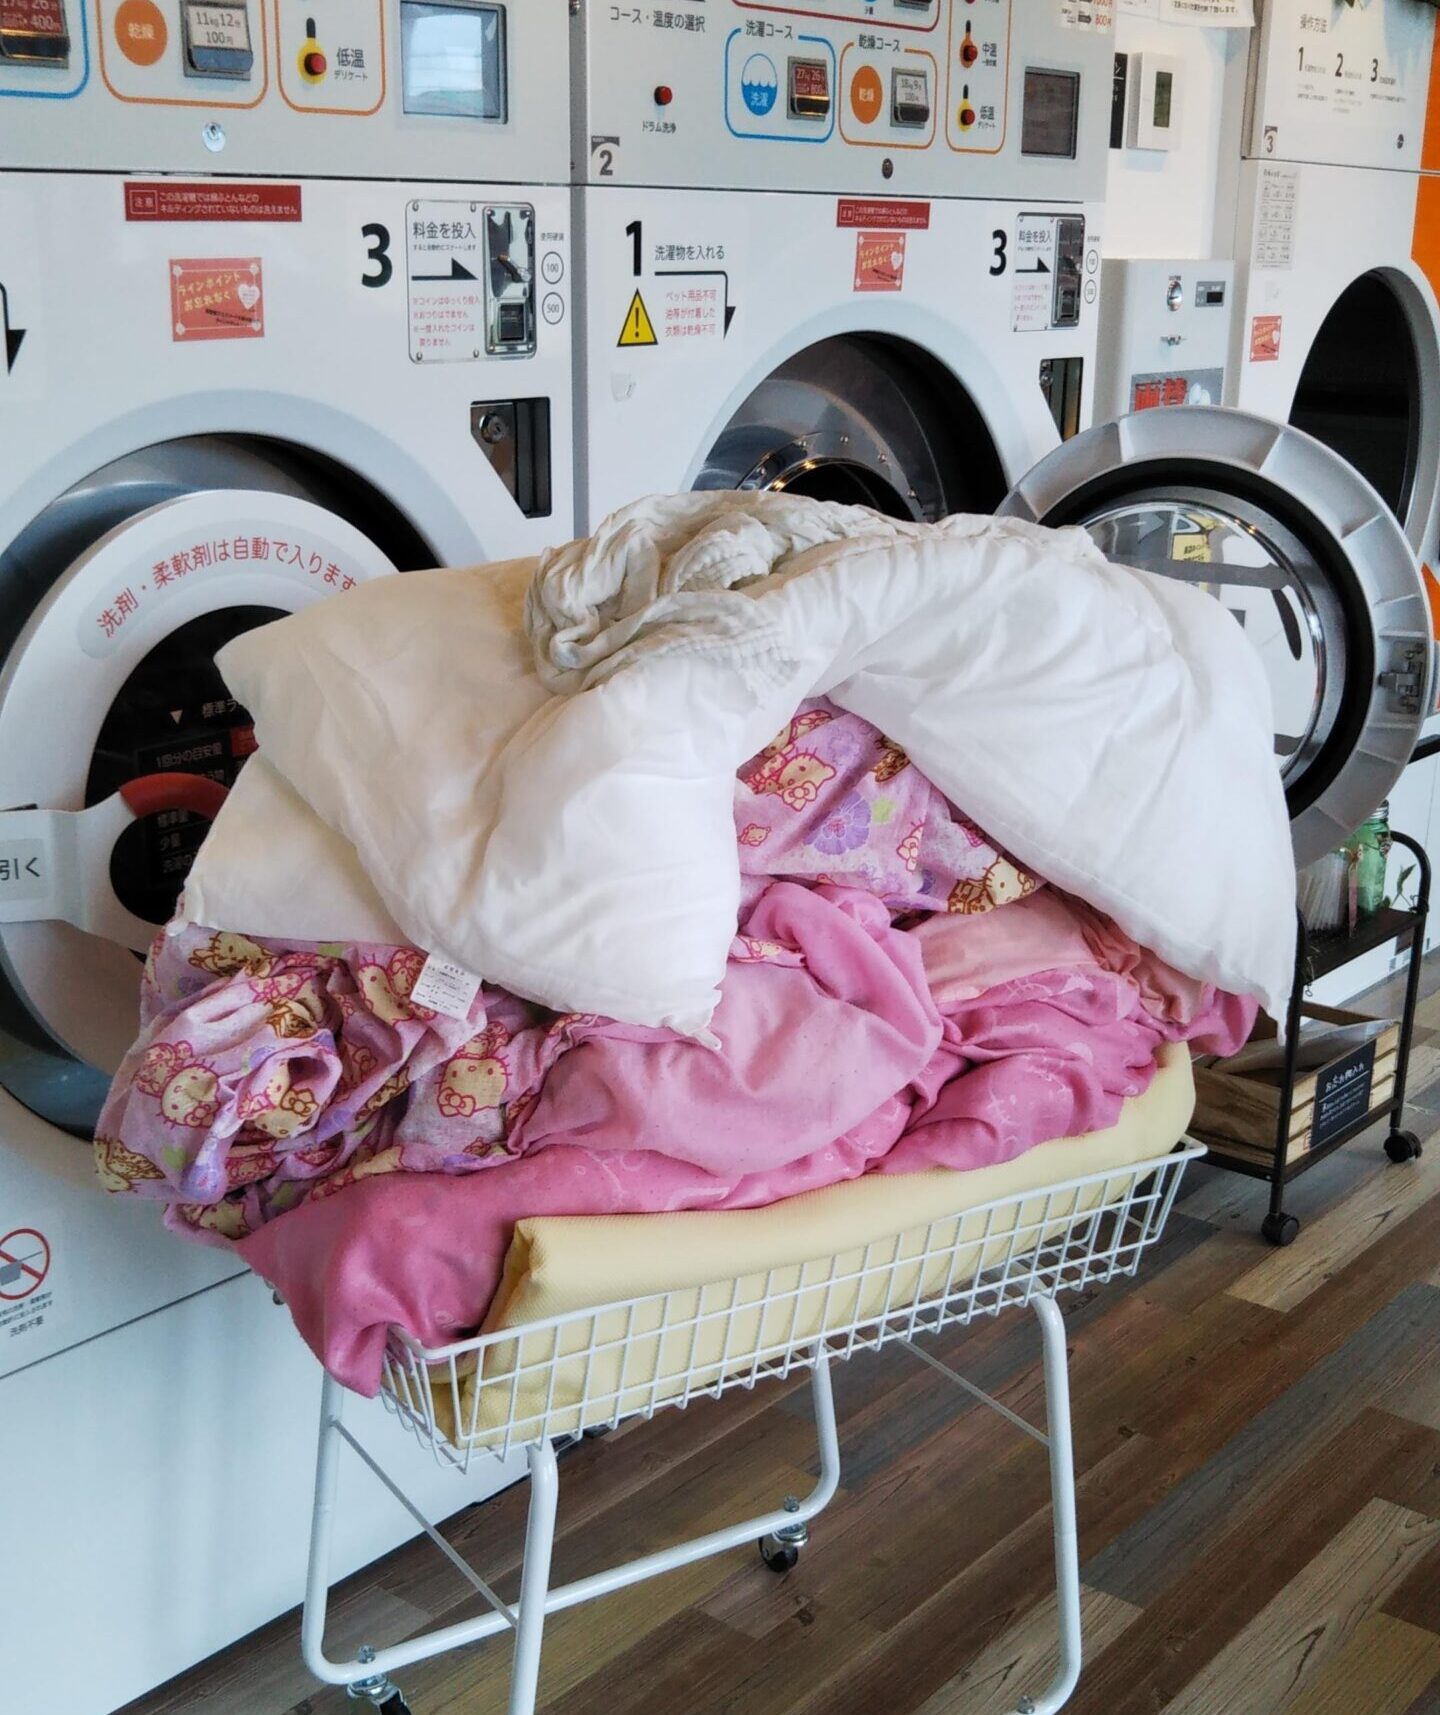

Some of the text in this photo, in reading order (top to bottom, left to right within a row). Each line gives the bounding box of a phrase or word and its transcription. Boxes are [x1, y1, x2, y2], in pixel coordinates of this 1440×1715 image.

[609, 6, 706, 33] コース・温度の選択
[745, 19, 794, 40] 洗濯コース
[858, 33, 901, 53] 乾燥コース
[336, 47, 366, 69] 低温
[1298, 46, 1304, 72] 1
[1335, 52, 1344, 77] 2
[334, 69, 369, 82] デリケート
[1370, 58, 1379, 82] 3
[750, 92, 769, 108] 洗濯
[1266, 135, 1274, 154] 3
[599, 149, 614, 176] 2
[412, 220, 477, 240] 料金を投入
[361, 222, 393, 288] 3
[625, 220, 642, 276] 1
[654, 245, 725, 261] 洗濯物を入れる
[989, 229, 1007, 277] 3
[546, 262, 560, 274] 100
[546, 302, 560, 315] 500
[96, 535, 358, 638] 洗剤・柔軟剤は自動で入ります
